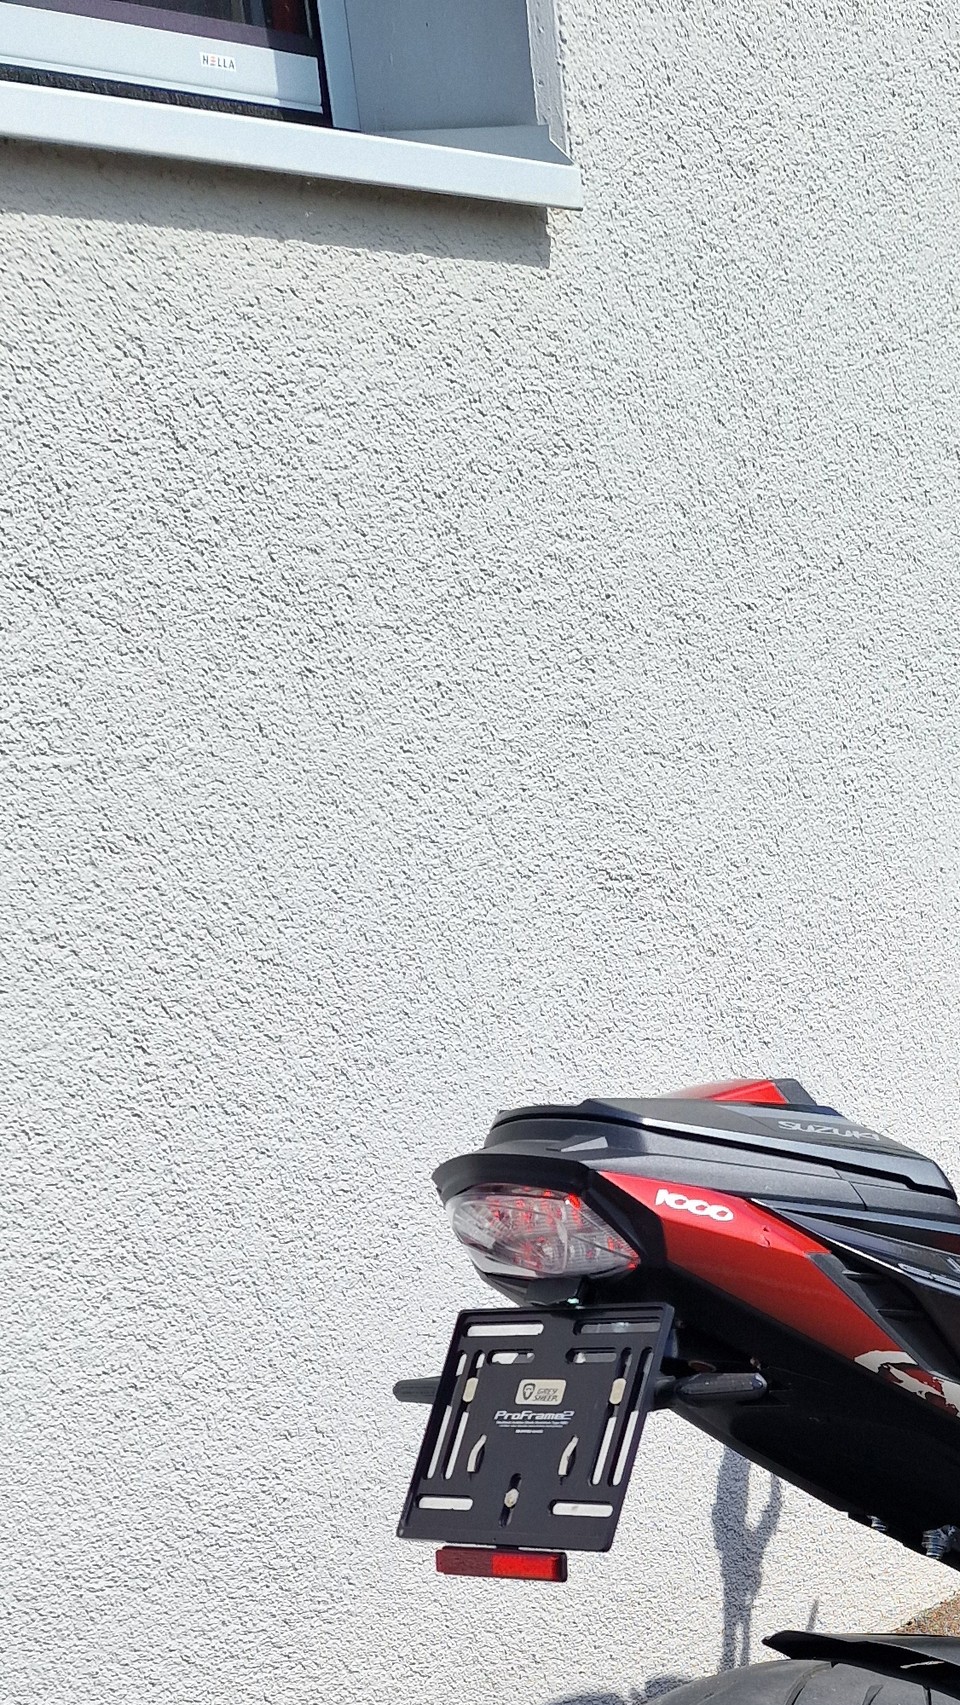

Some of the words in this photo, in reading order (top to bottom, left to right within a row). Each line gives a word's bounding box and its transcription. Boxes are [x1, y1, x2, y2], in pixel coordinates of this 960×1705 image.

[202, 54, 235, 70] HELLA
[778, 1121, 881, 1142] SUZUKI
[655, 1188, 734, 1222] 1000
[494, 1410, 575, 1420] ProFrame2
